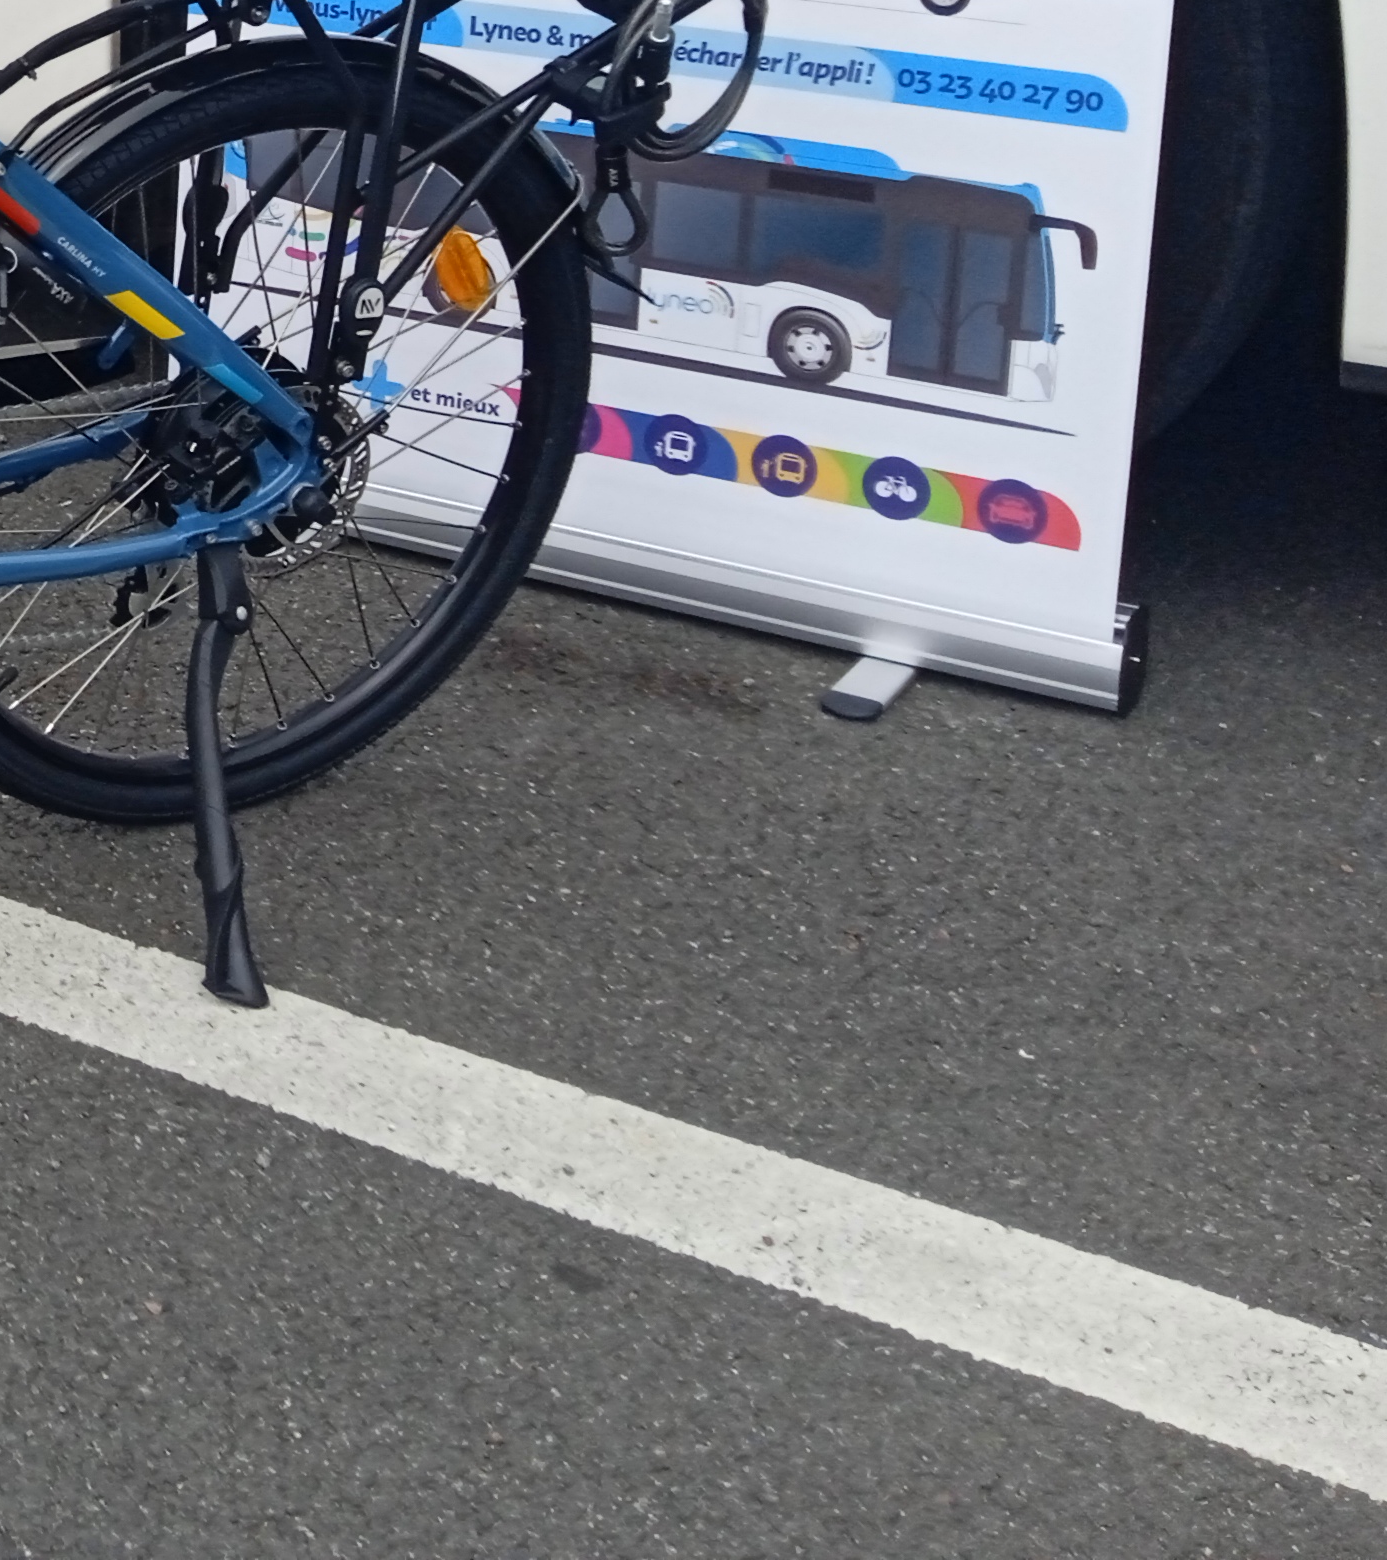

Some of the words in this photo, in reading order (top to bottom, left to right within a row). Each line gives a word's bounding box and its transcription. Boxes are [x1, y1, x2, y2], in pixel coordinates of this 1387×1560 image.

[469, 15, 542, 46] Lyneo
[545, 24, 566, 46] &
[897, 66, 933, 96] 03
[938, 71, 973, 101] 23
[977, 75, 1017, 106] 40
[1022, 82, 1058, 112] 27
[1065, 89, 1104, 115] 90
[410, 385, 431, 404] et
[435, 392, 501, 417] mieux
